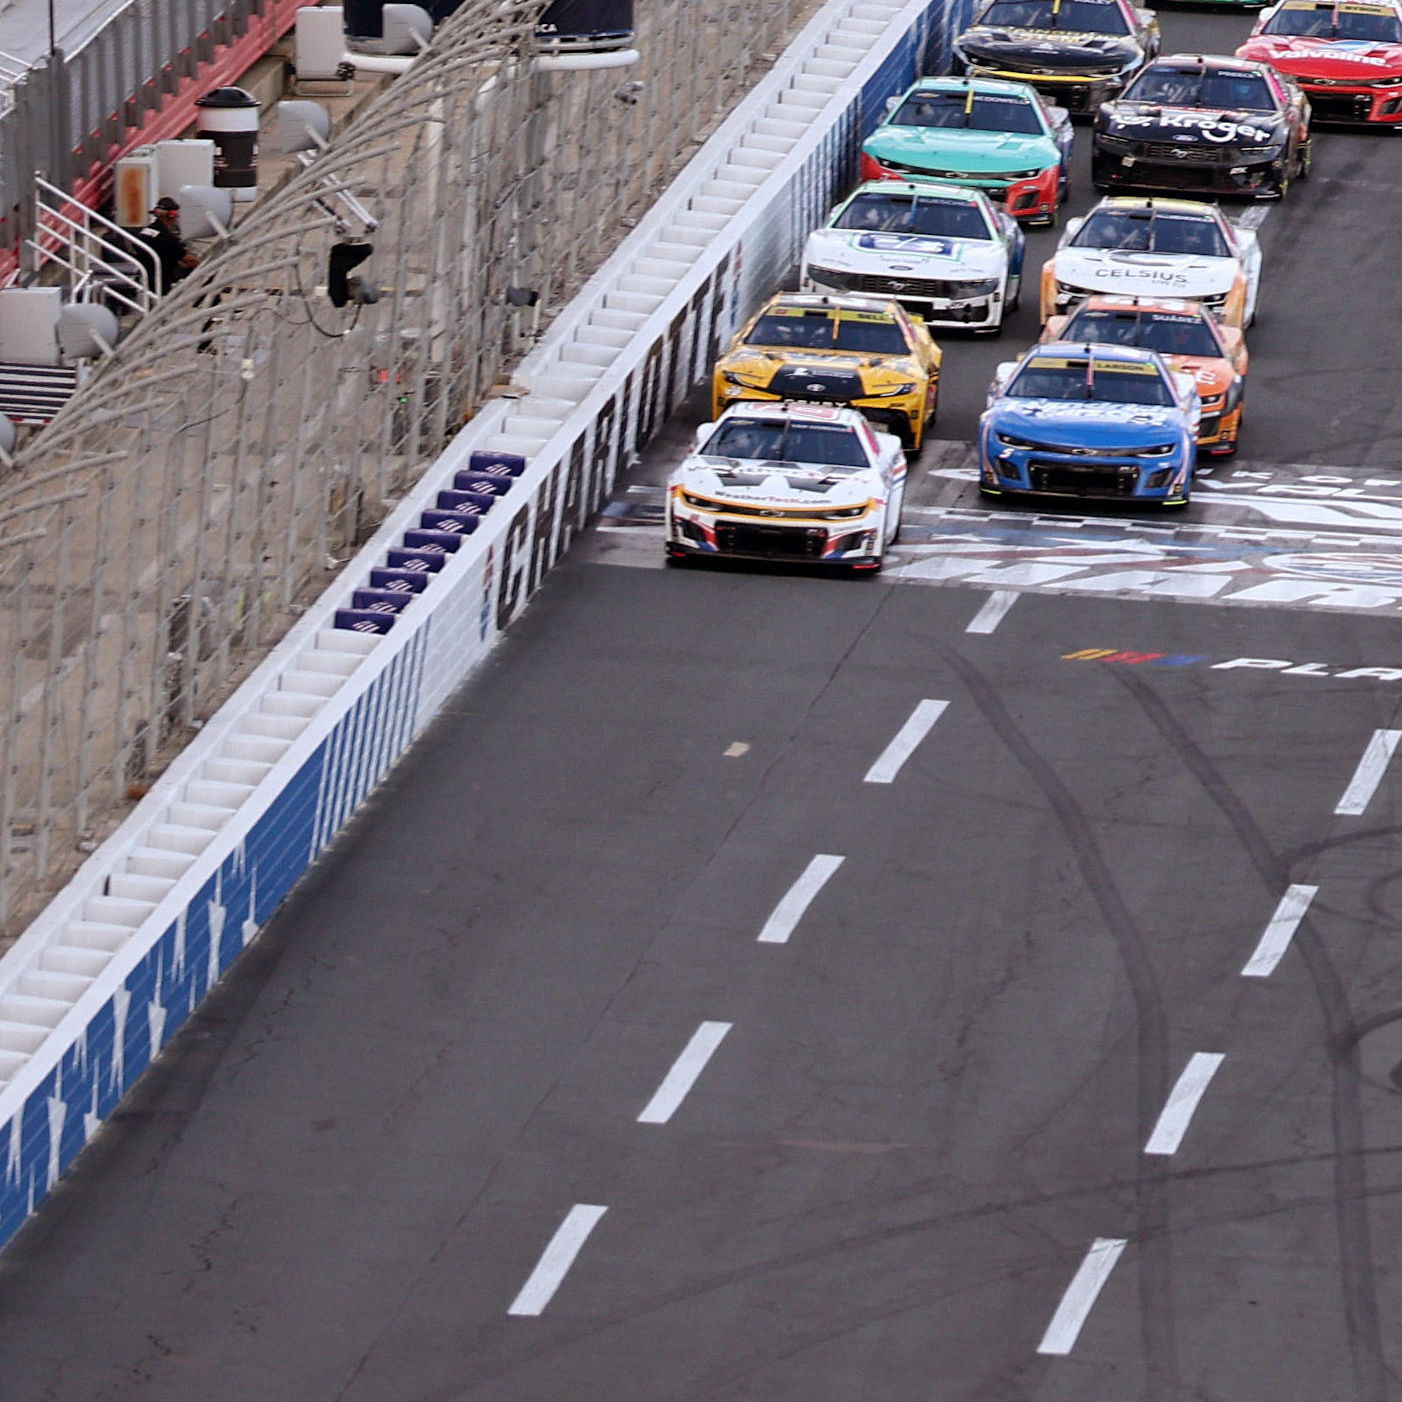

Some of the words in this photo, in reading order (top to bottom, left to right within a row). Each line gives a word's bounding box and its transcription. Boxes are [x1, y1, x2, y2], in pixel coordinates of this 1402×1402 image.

[1268, 50, 1388, 66] Valvoline
[1160, 114, 1271, 143] Kroger
[1095, 268, 1188, 283] CELSIUS
[1301, 475, 1402, 487] OF
